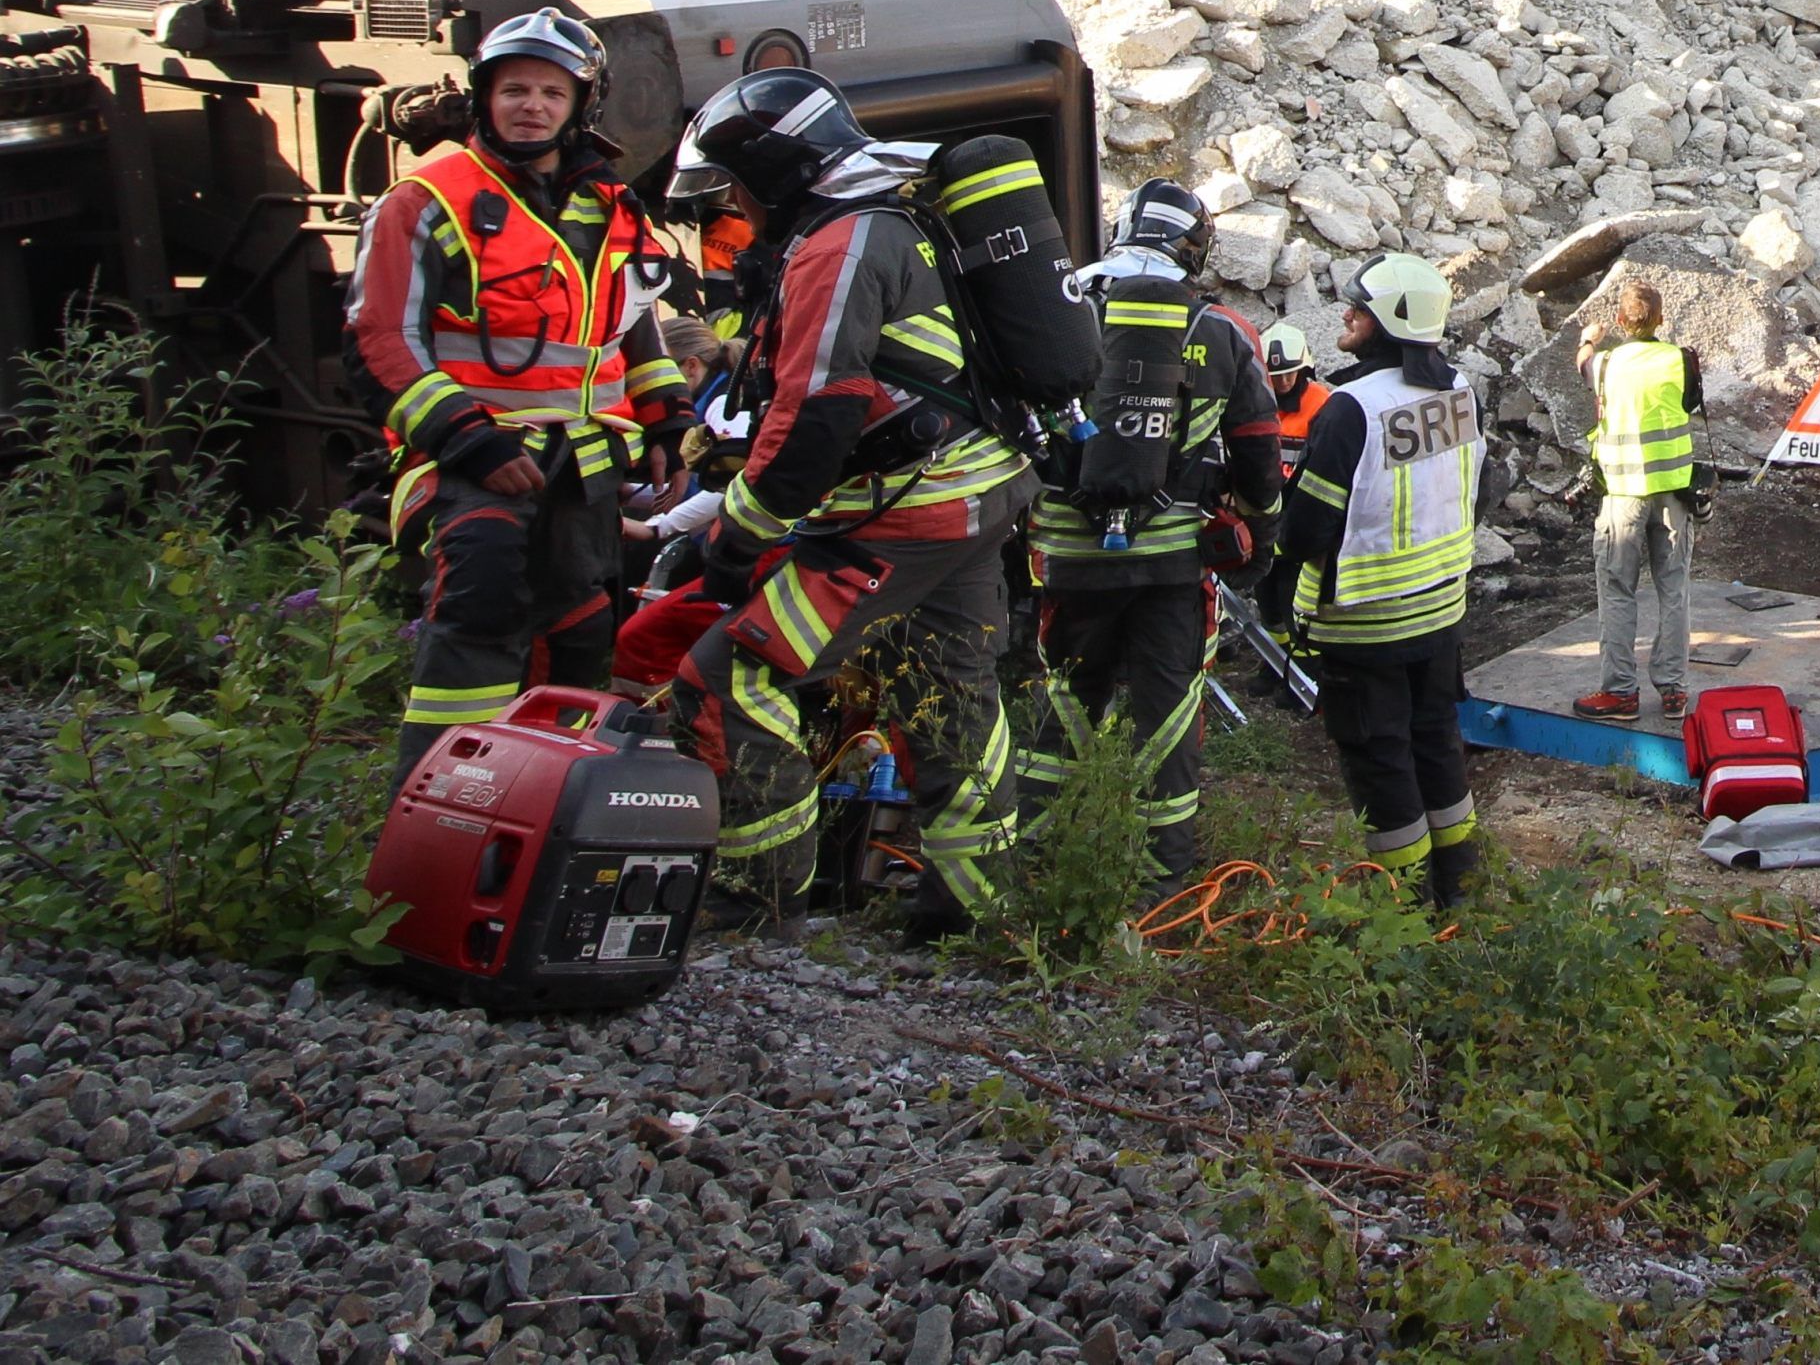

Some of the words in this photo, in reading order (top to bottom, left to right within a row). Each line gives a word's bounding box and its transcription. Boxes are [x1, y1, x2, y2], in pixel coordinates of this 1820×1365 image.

[1388, 390, 1470, 461] SRF
[452, 763, 495, 783] HONDA
[608, 791, 702, 809] HONDA
